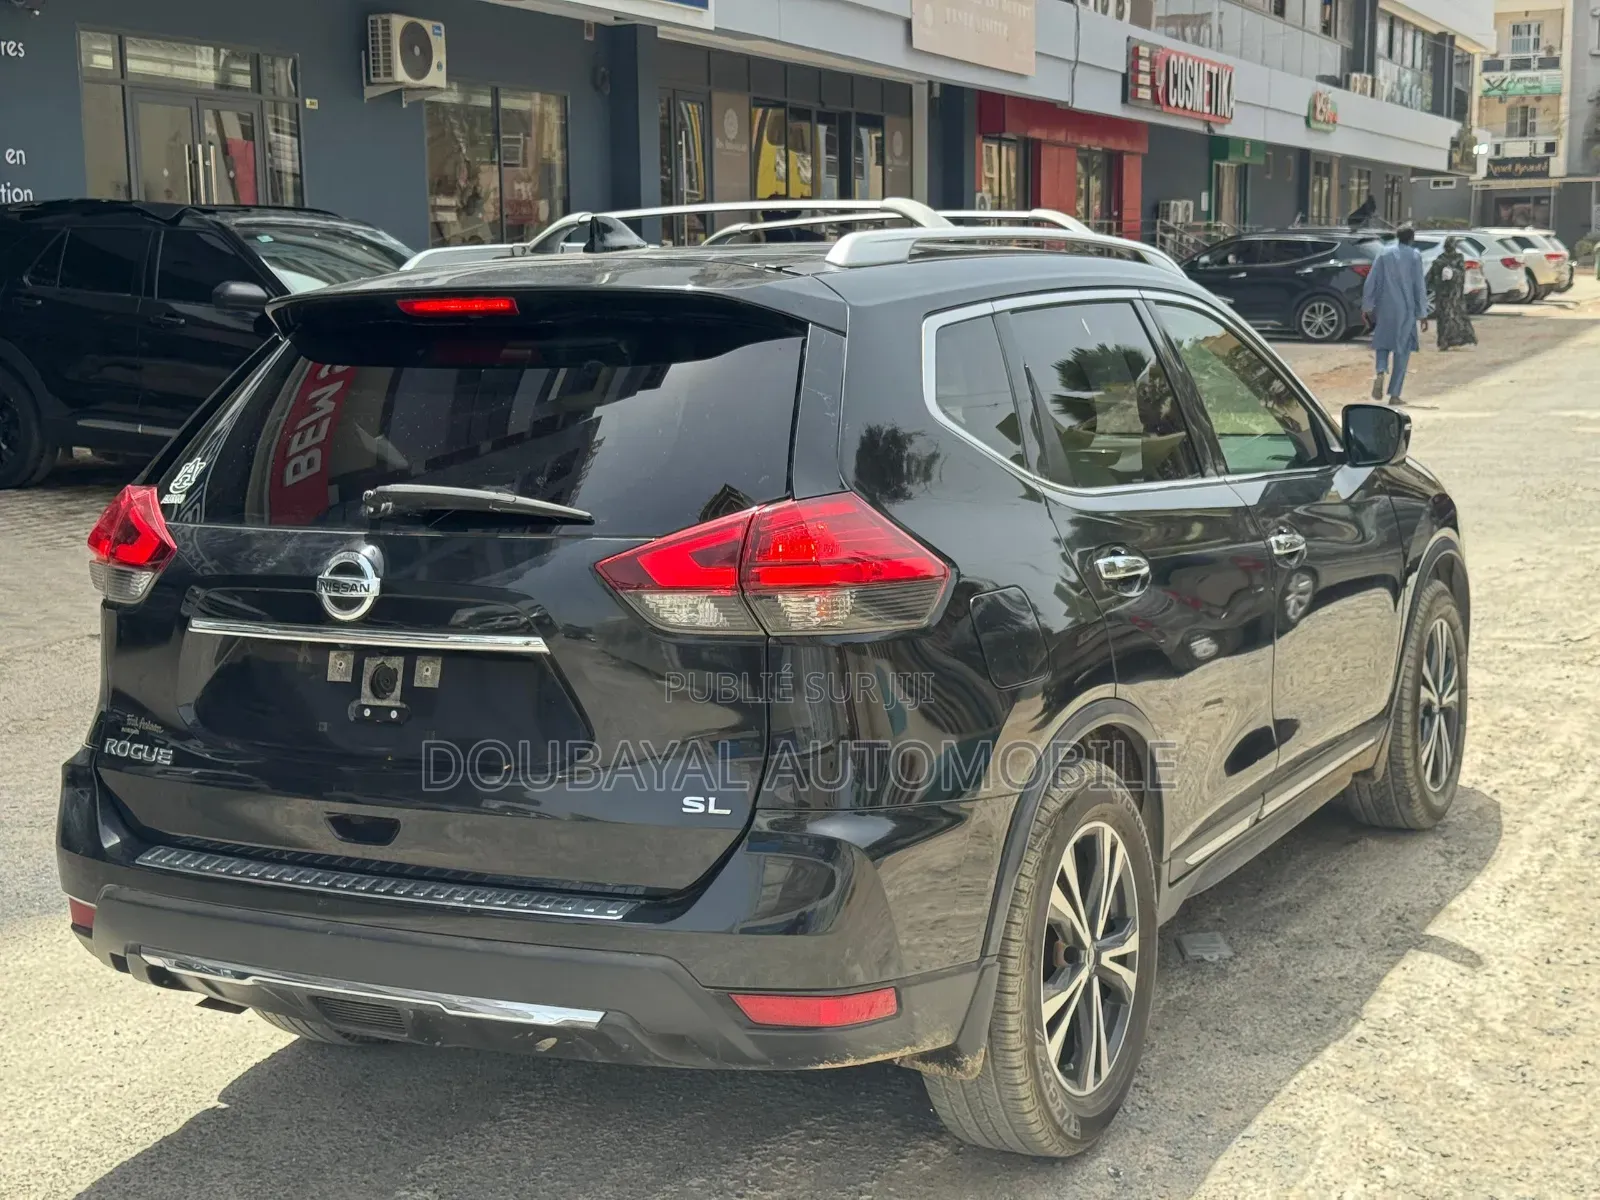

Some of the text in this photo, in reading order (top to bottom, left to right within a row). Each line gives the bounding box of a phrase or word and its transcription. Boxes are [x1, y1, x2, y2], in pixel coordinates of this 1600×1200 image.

[1168, 53, 1236, 119] COSMETIKA
[5, 148, 26, 165] en
[319, 581, 371, 594] NISSAN
[103, 737, 173, 766] ROGUE
[681, 796, 732, 815] SL
